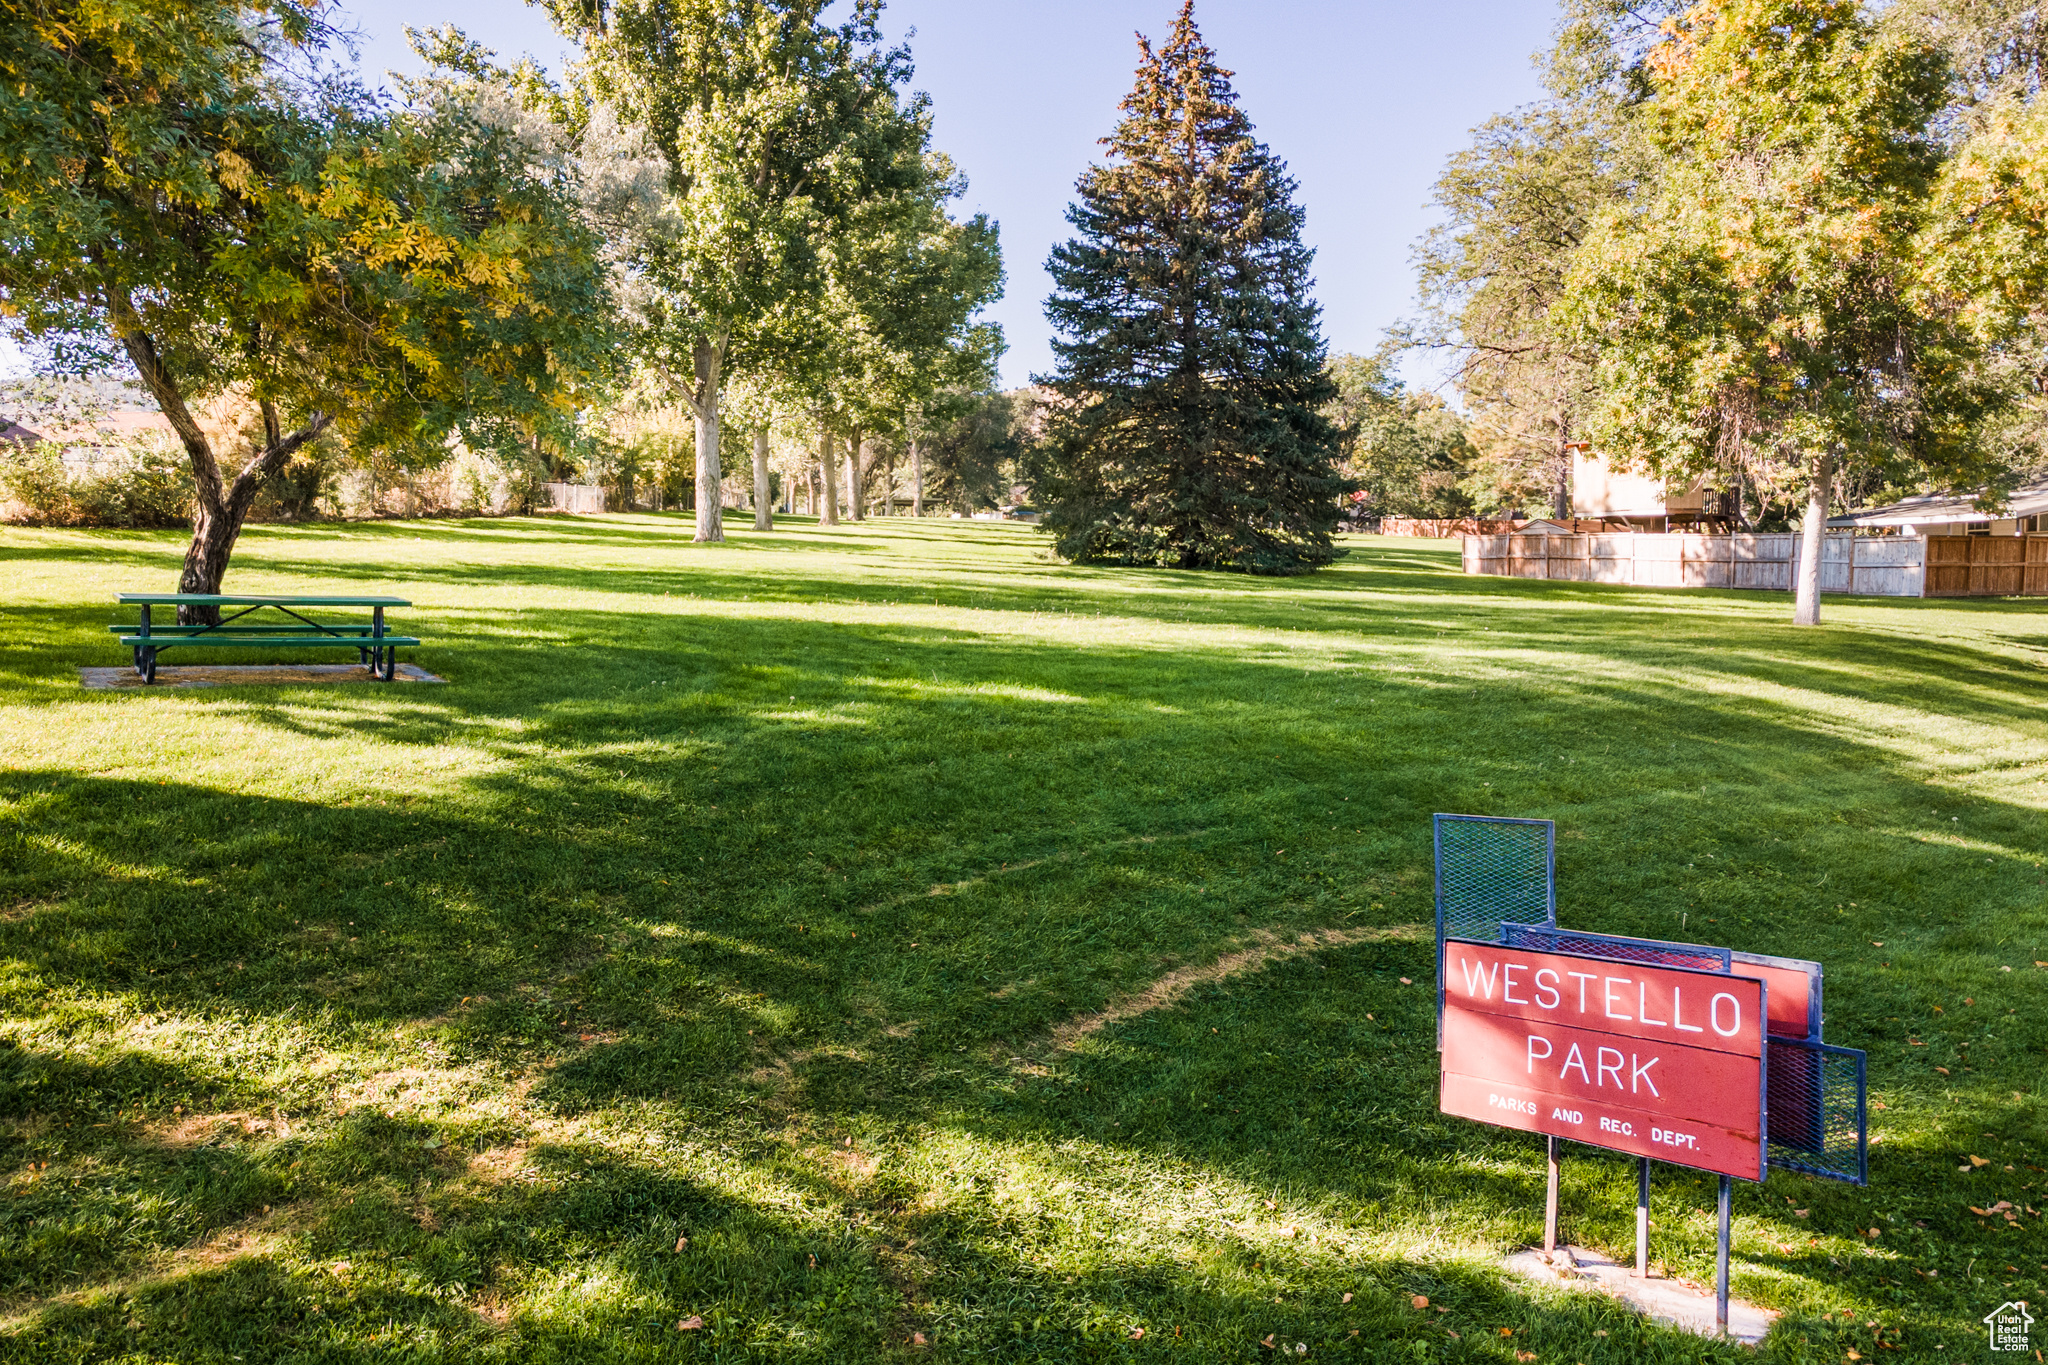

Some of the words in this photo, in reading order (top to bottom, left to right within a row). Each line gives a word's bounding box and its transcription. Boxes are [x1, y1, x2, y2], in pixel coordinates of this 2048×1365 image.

[1461, 958, 1741, 1037] WESTELLO
[1527, 1035, 1660, 1098] PARK
[1489, 1093, 1537, 1115] PARKS
[1552, 1107, 1583, 1125] AND
[1600, 1116, 1637, 1137] REC.
[1651, 1127, 1700, 1150] DEPT.
